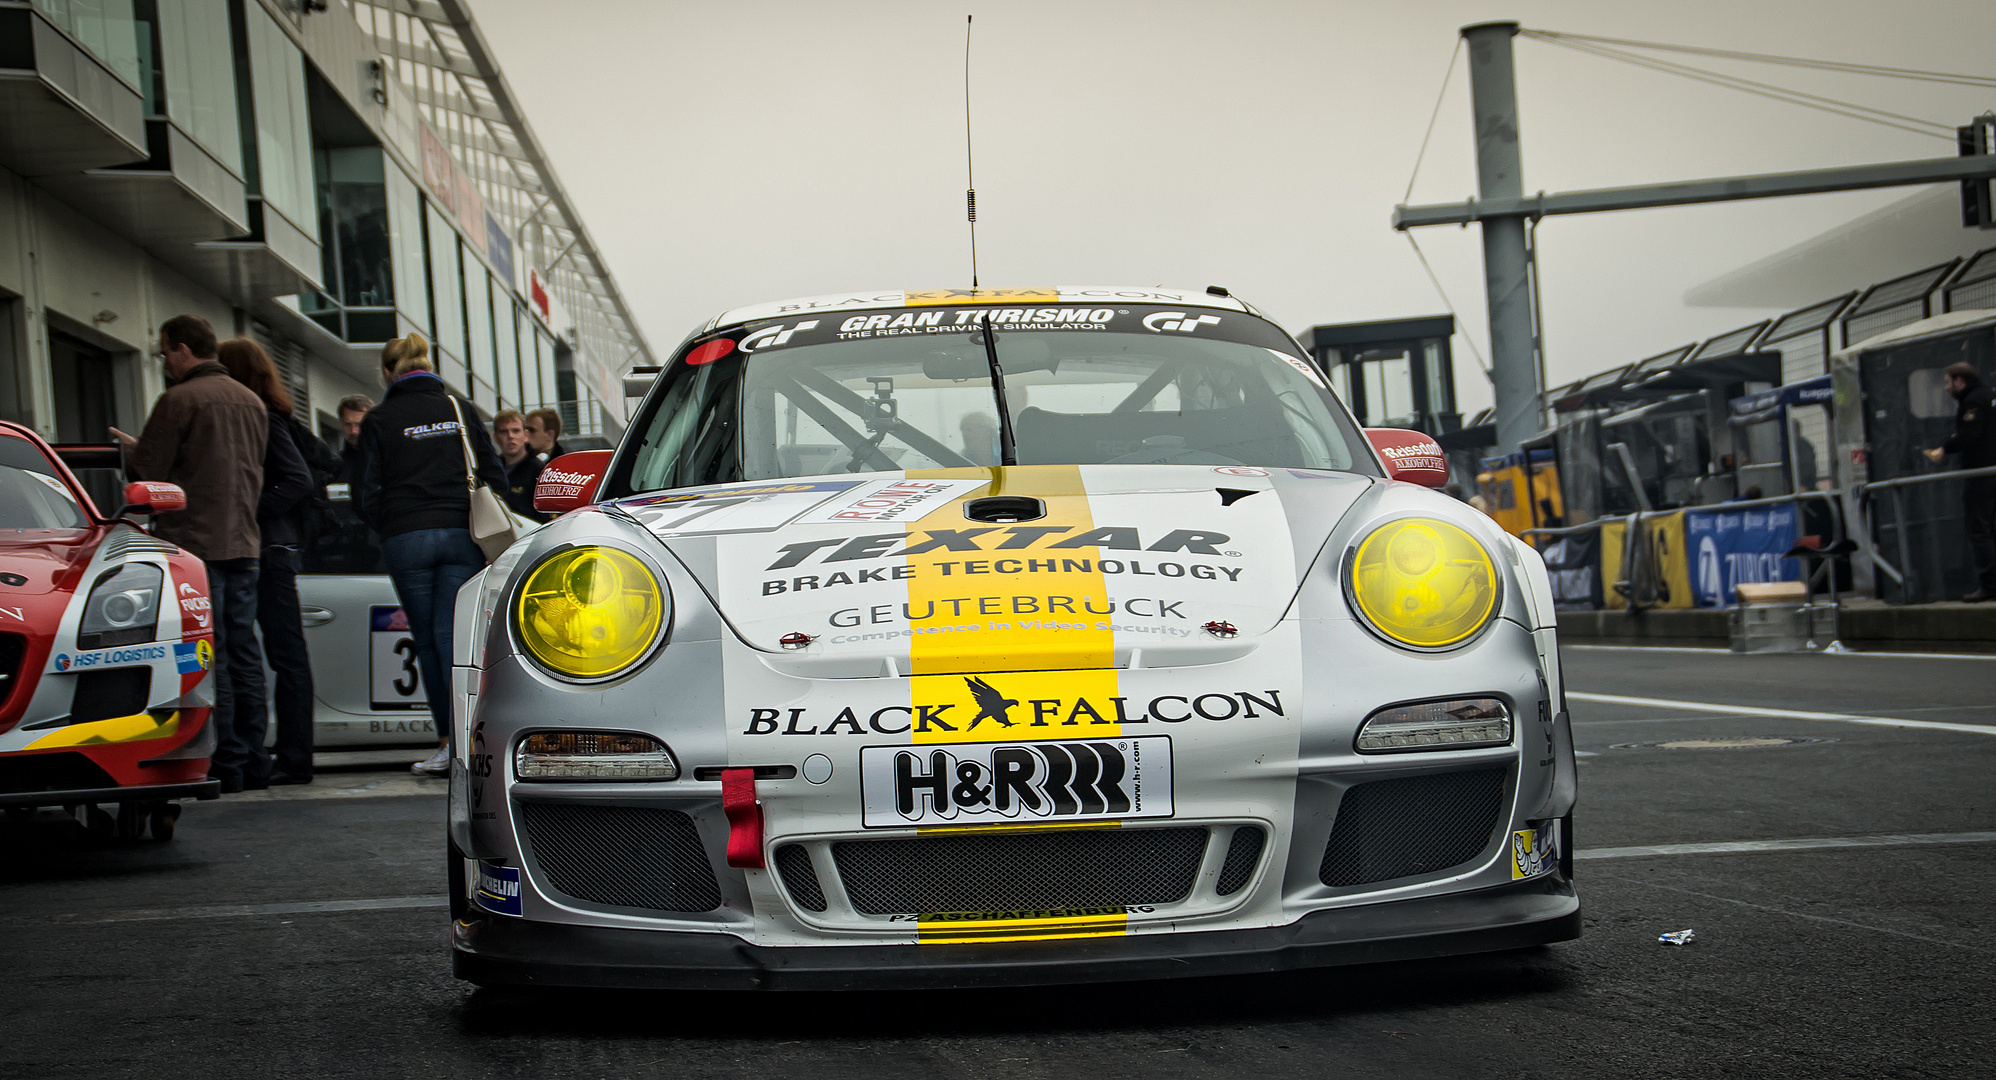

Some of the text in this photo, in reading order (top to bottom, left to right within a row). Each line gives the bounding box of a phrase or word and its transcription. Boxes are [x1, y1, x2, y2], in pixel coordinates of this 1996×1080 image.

[777, 288, 1183, 313] BLACK FALCON
[836, 322, 1107, 340] THE REAL DRIVING SIMULATOR
[839, 308, 1115, 333] GRAN TURISMO
[403, 421, 461, 436] FALKEN
[1381, 441, 1442, 459] Reissdorf
[539, 467, 596, 486] Reissdorf
[833, 482, 936, 520] ROWE
[874, 493, 933, 521] MOTOR
[764, 526, 1231, 572] TEXTAR
[761, 558, 1243, 597] BRAKE TECHNOLOGY
[180, 596, 212, 612] FUCHS
[830, 619, 1192, 645] Competence in Video Security
[74, 652, 103, 667] HSF
[104, 646, 166, 664] LOGISTICS
[743, 689, 1285, 736] BLACK FALCON
[369, 720, 436, 734] BLACK
[927, 904, 1156, 922] ASCHAFFENBURG
